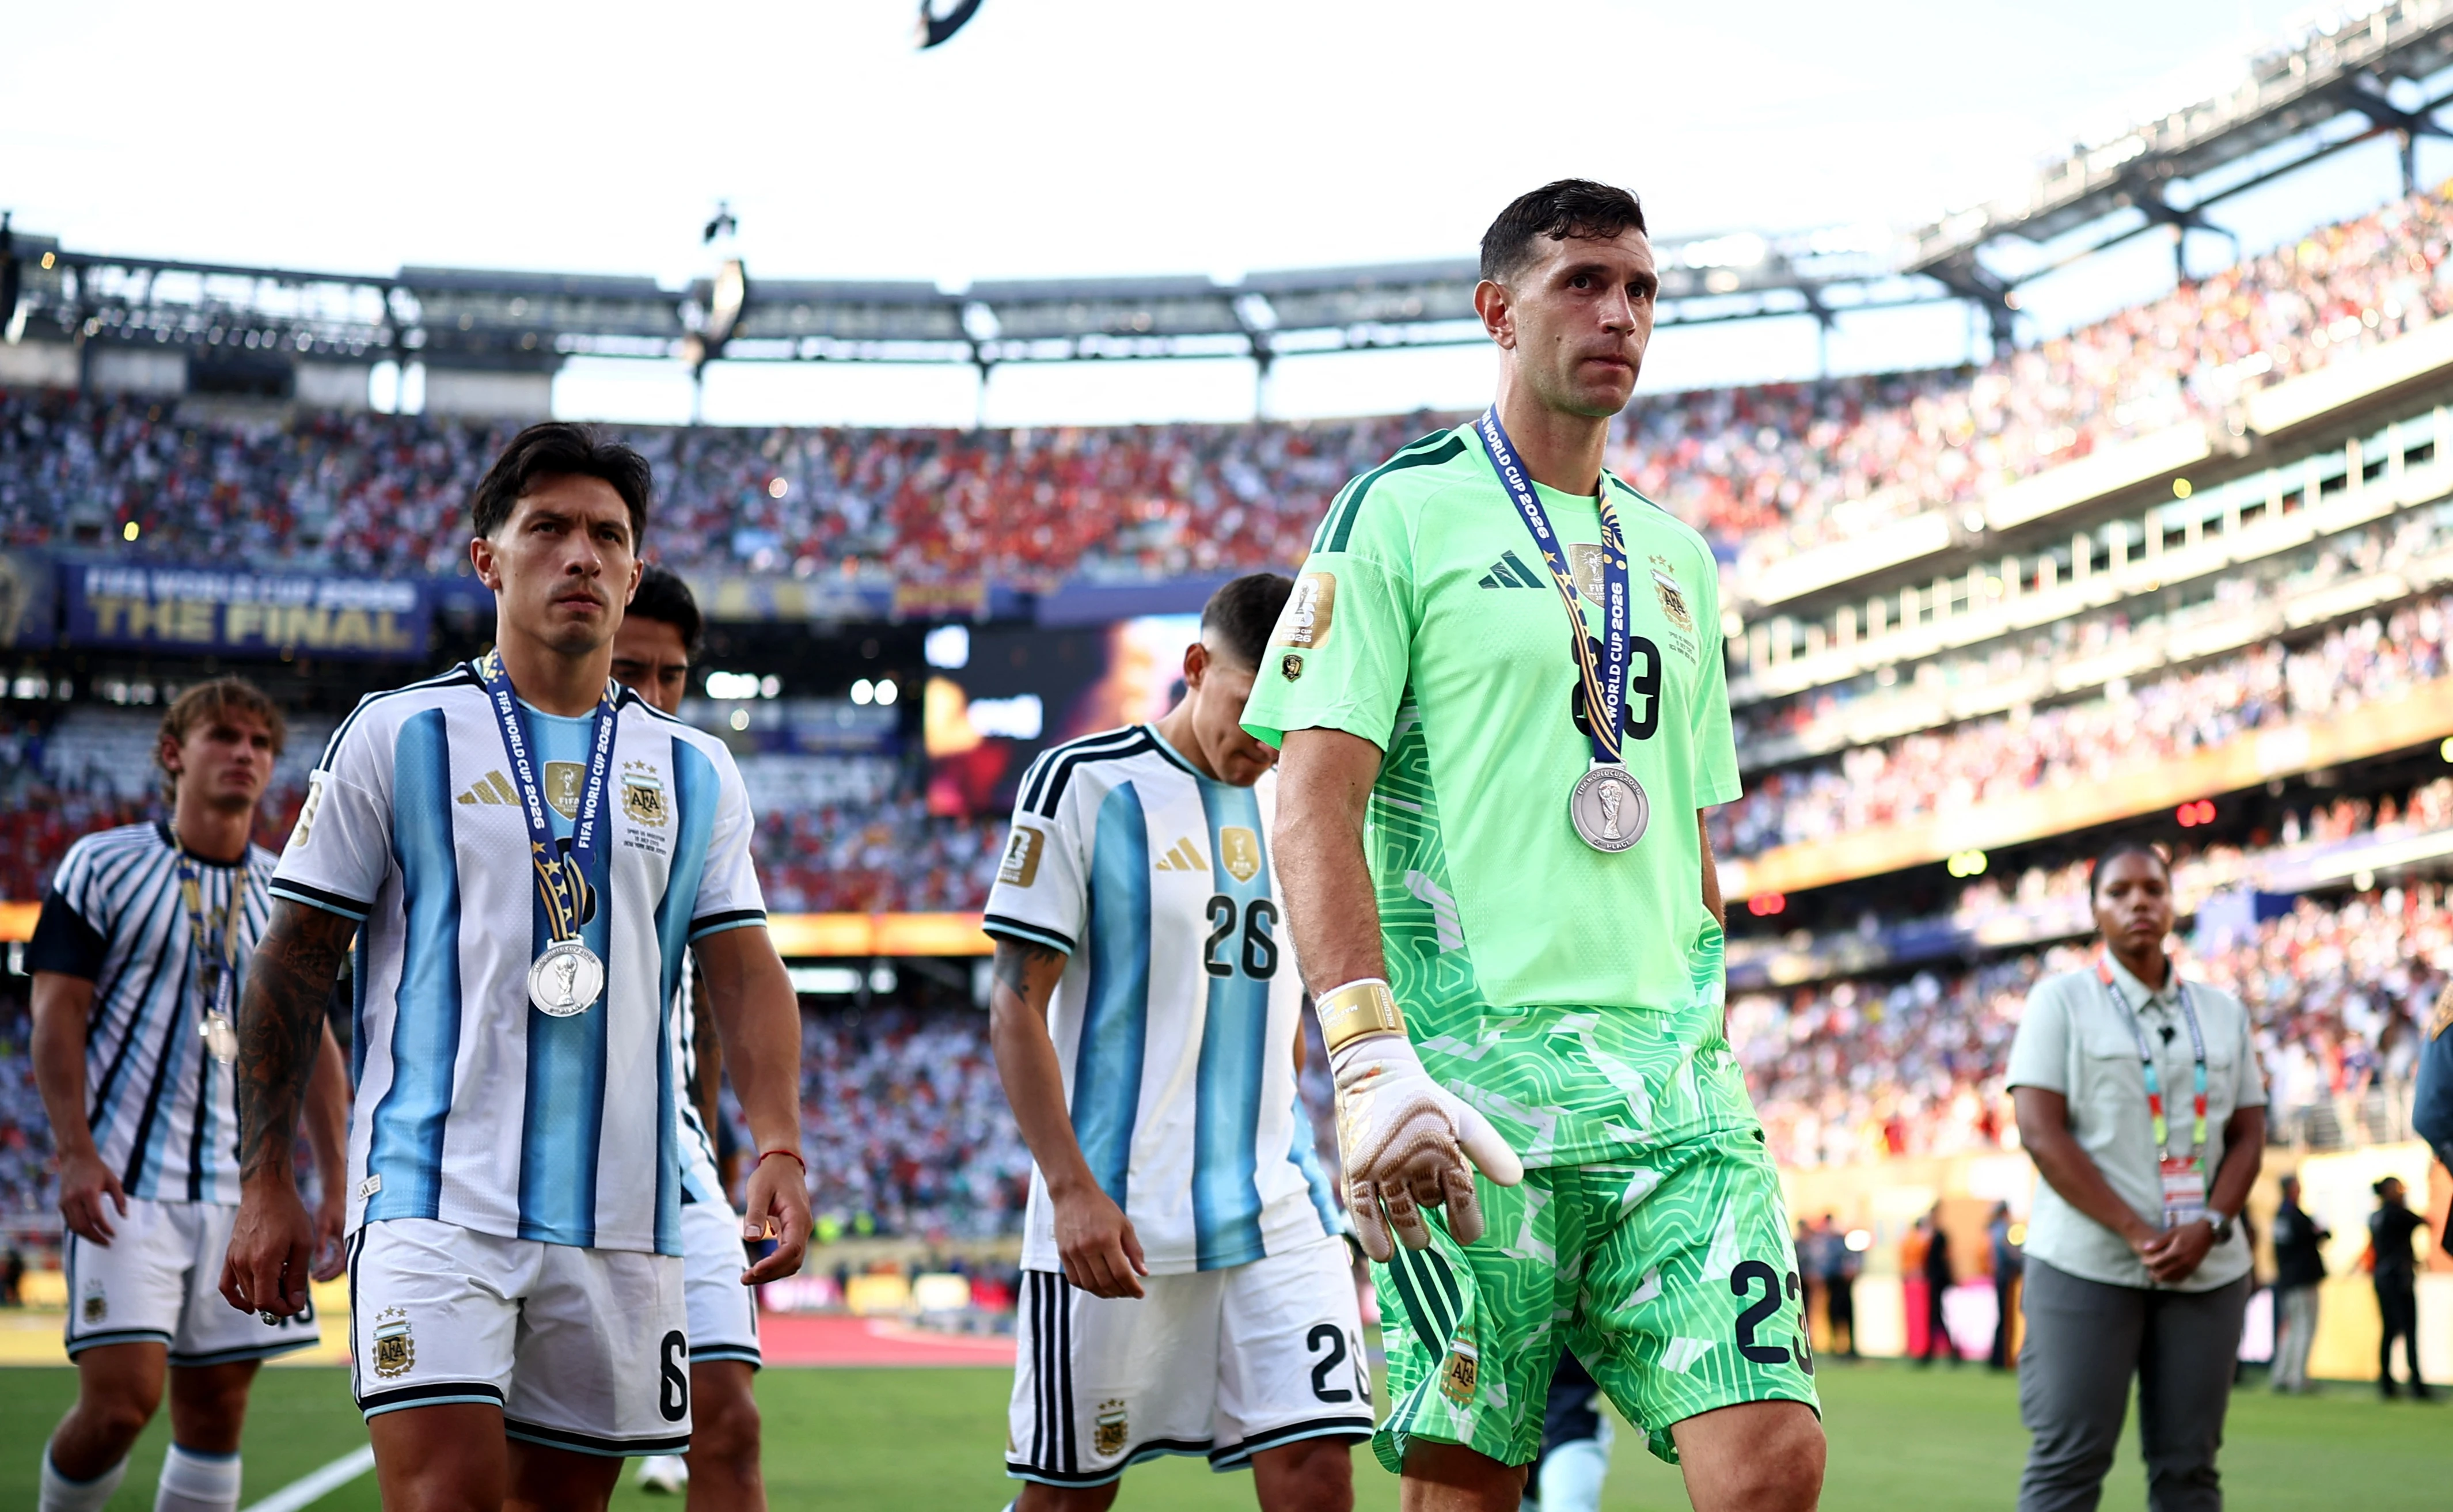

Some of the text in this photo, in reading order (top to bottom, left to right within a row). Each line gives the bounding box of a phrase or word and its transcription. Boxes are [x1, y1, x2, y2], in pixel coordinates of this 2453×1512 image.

[1483, 420, 1511, 466] WORLD
[1505, 466, 1526, 492] CUP
[1518, 493, 1550, 539] 2026
[1589, 584, 1605, 592] FIF
[90, 596, 412, 648] THE FINAL
[1607, 582, 1623, 723] WORLD CUP 2026
[496, 690, 545, 830] FIFA WORLD CUP 2026
[578, 715, 613, 849] FIFA WORLD CUP 2026
[1586, 770, 1609, 785] WORLD
[1623, 776, 1642, 795] 2026
[631, 787, 660, 812] AFA
[1607, 840, 1631, 849] PLACE
[1205, 895, 1278, 981] 26
[1379, 987, 1396, 1027] PREDATOR
[1730, 1260, 1814, 1376] 23
[380, 1336, 405, 1362] AFA
[1451, 1355, 1474, 1387] AFA
[659, 1330, 688, 1422] 6
